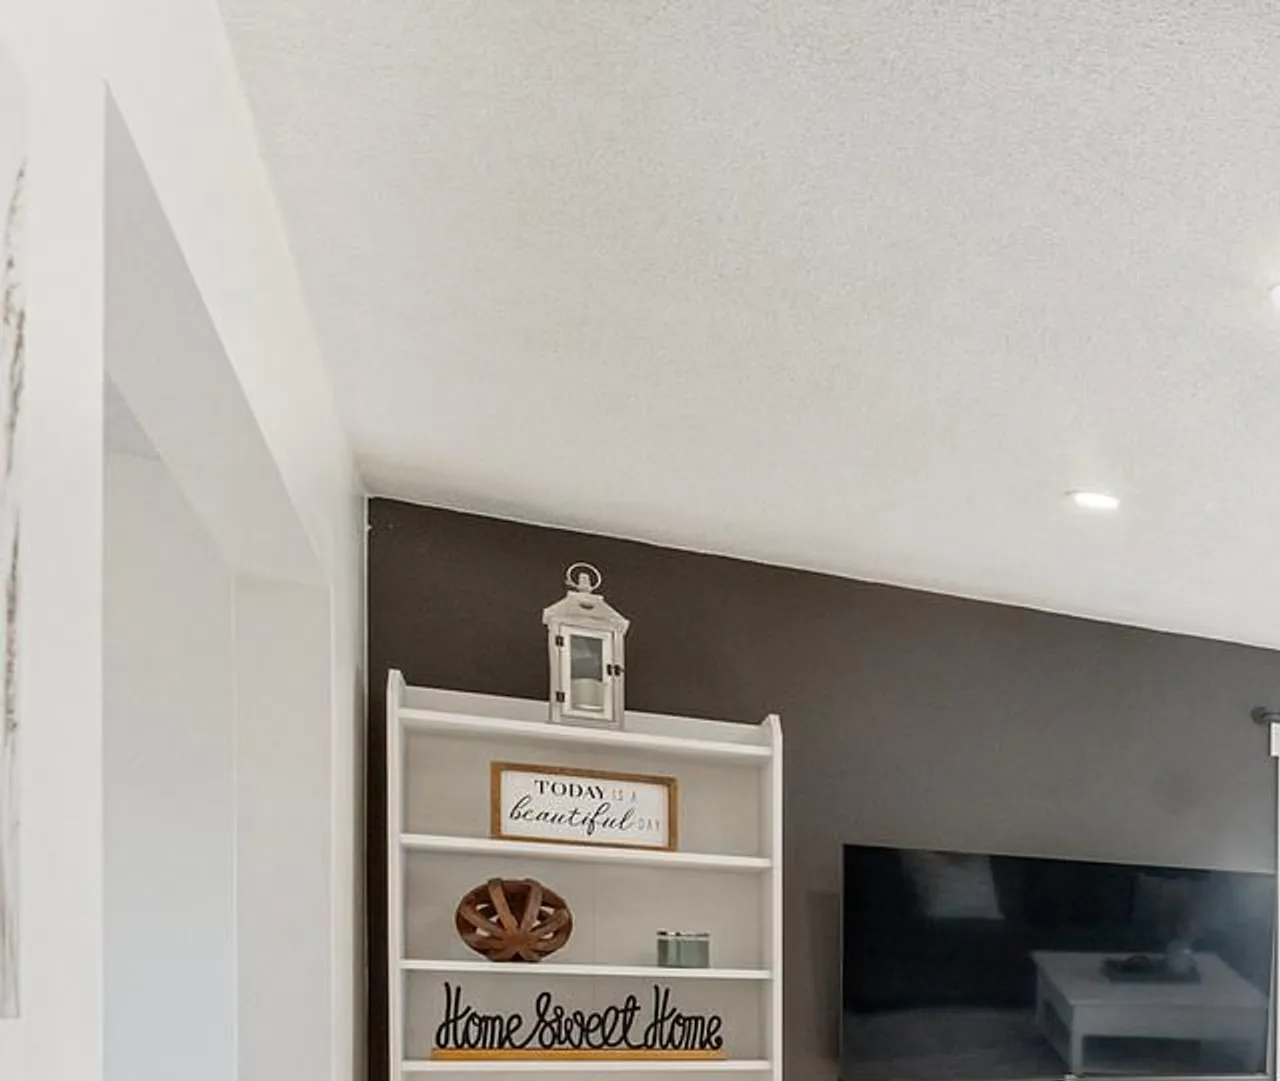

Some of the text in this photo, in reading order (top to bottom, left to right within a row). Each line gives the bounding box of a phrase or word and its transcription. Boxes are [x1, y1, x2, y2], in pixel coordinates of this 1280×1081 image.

[534, 779, 605, 800] TODAY
[509, 795, 660, 836] beautiful DAY
[435, 982, 723, 1050] Home Sweet Home
